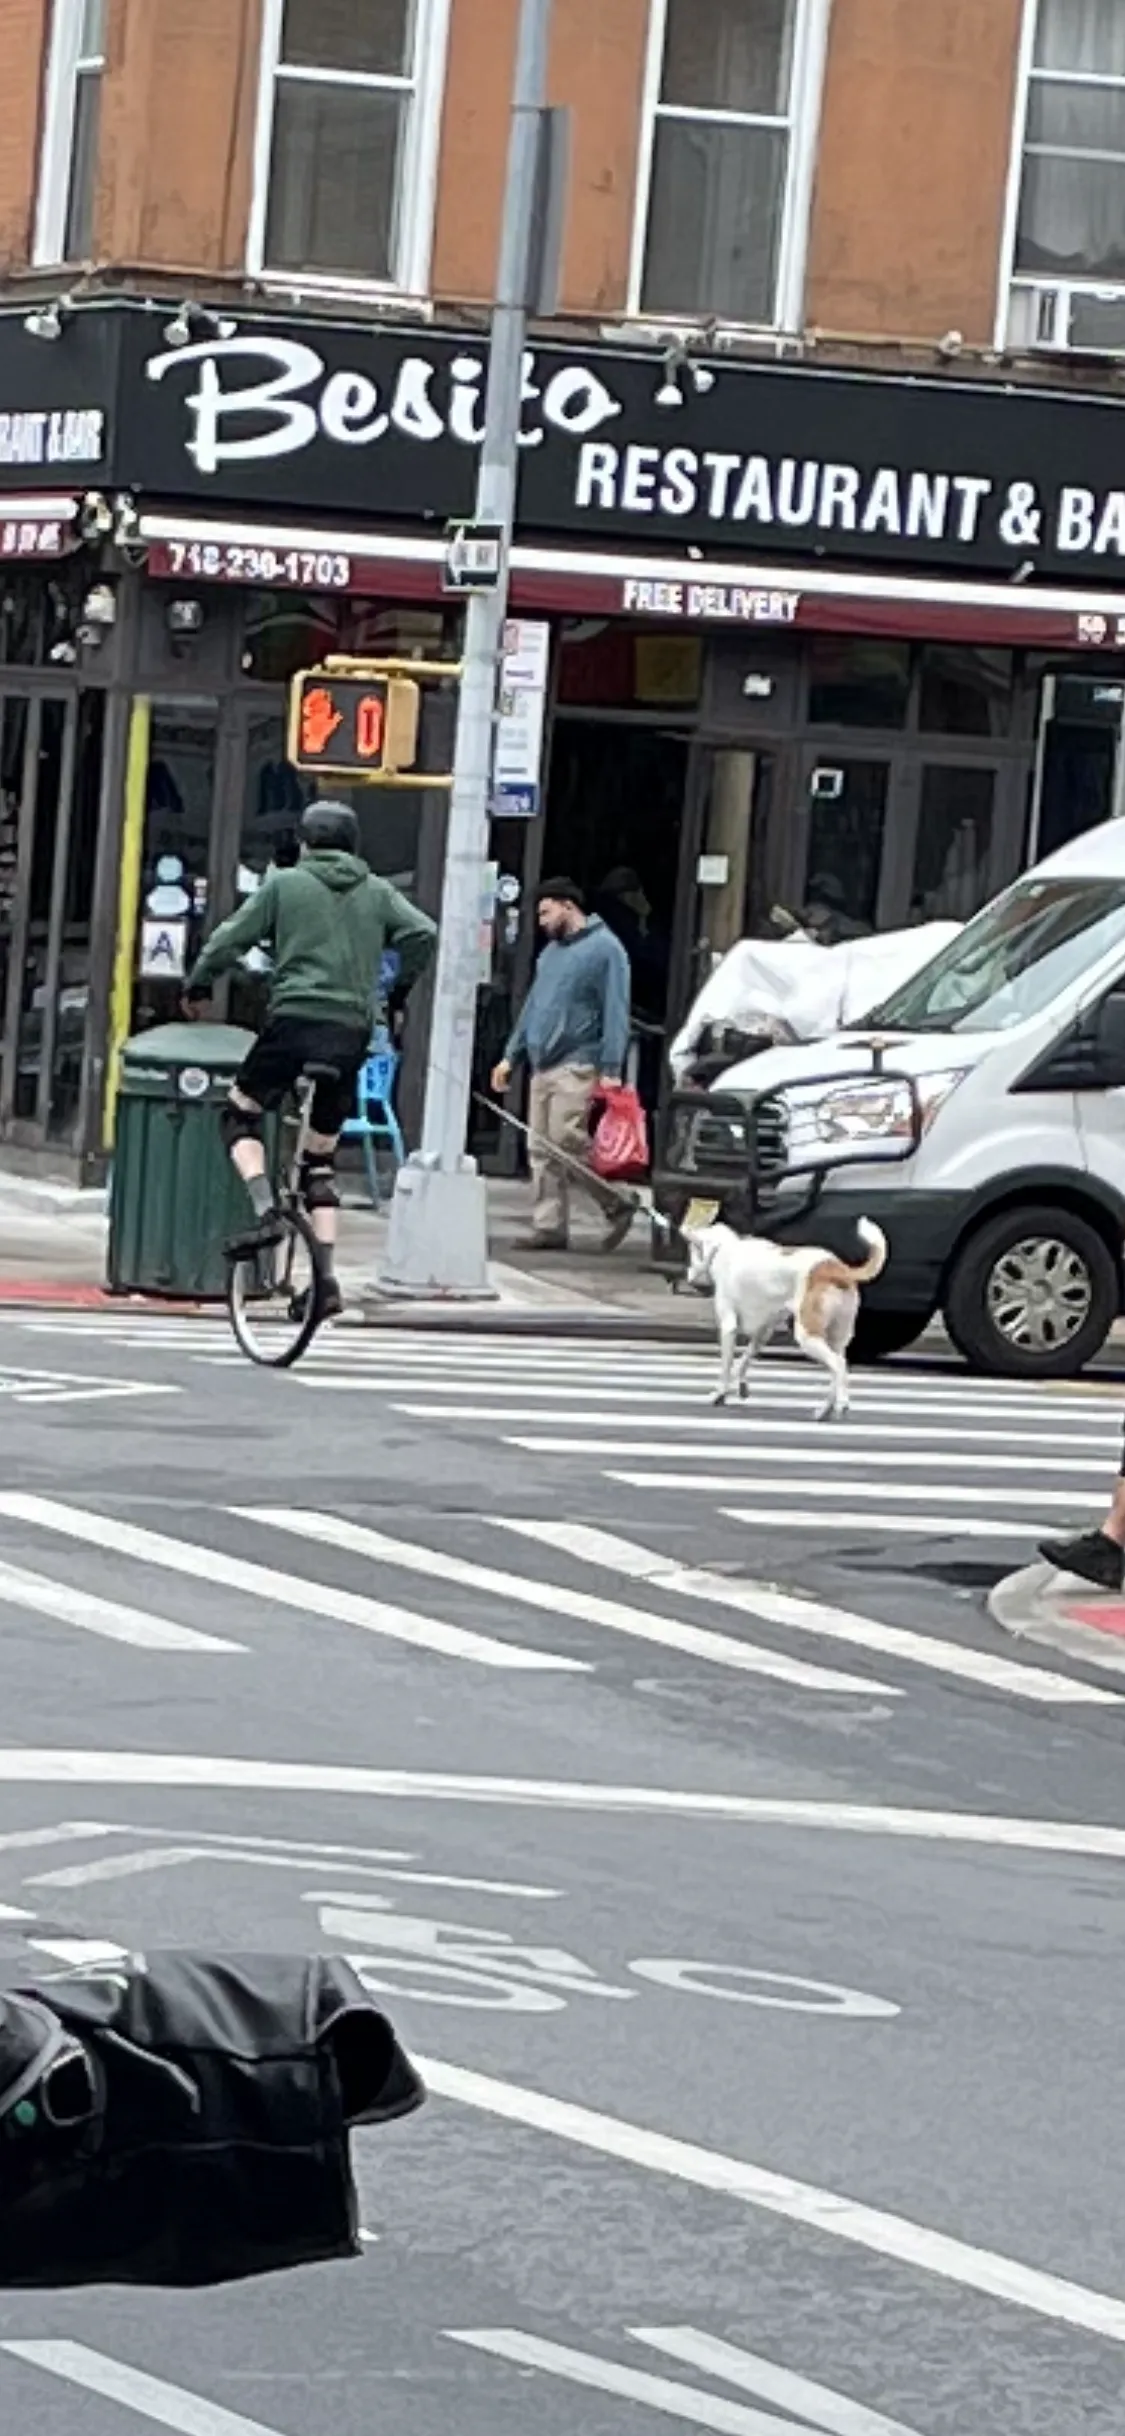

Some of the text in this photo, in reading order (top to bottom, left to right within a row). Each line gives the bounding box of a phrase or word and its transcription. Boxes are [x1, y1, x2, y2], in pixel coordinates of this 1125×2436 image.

[576, 442, 991, 543] RESTAURANT
[998, 481, 1041, 546] &
[168, 541, 351, 588] 718-230-1703
[623, 579, 801, 624] FREE DELIVERY
[149, 930, 175, 962] A
